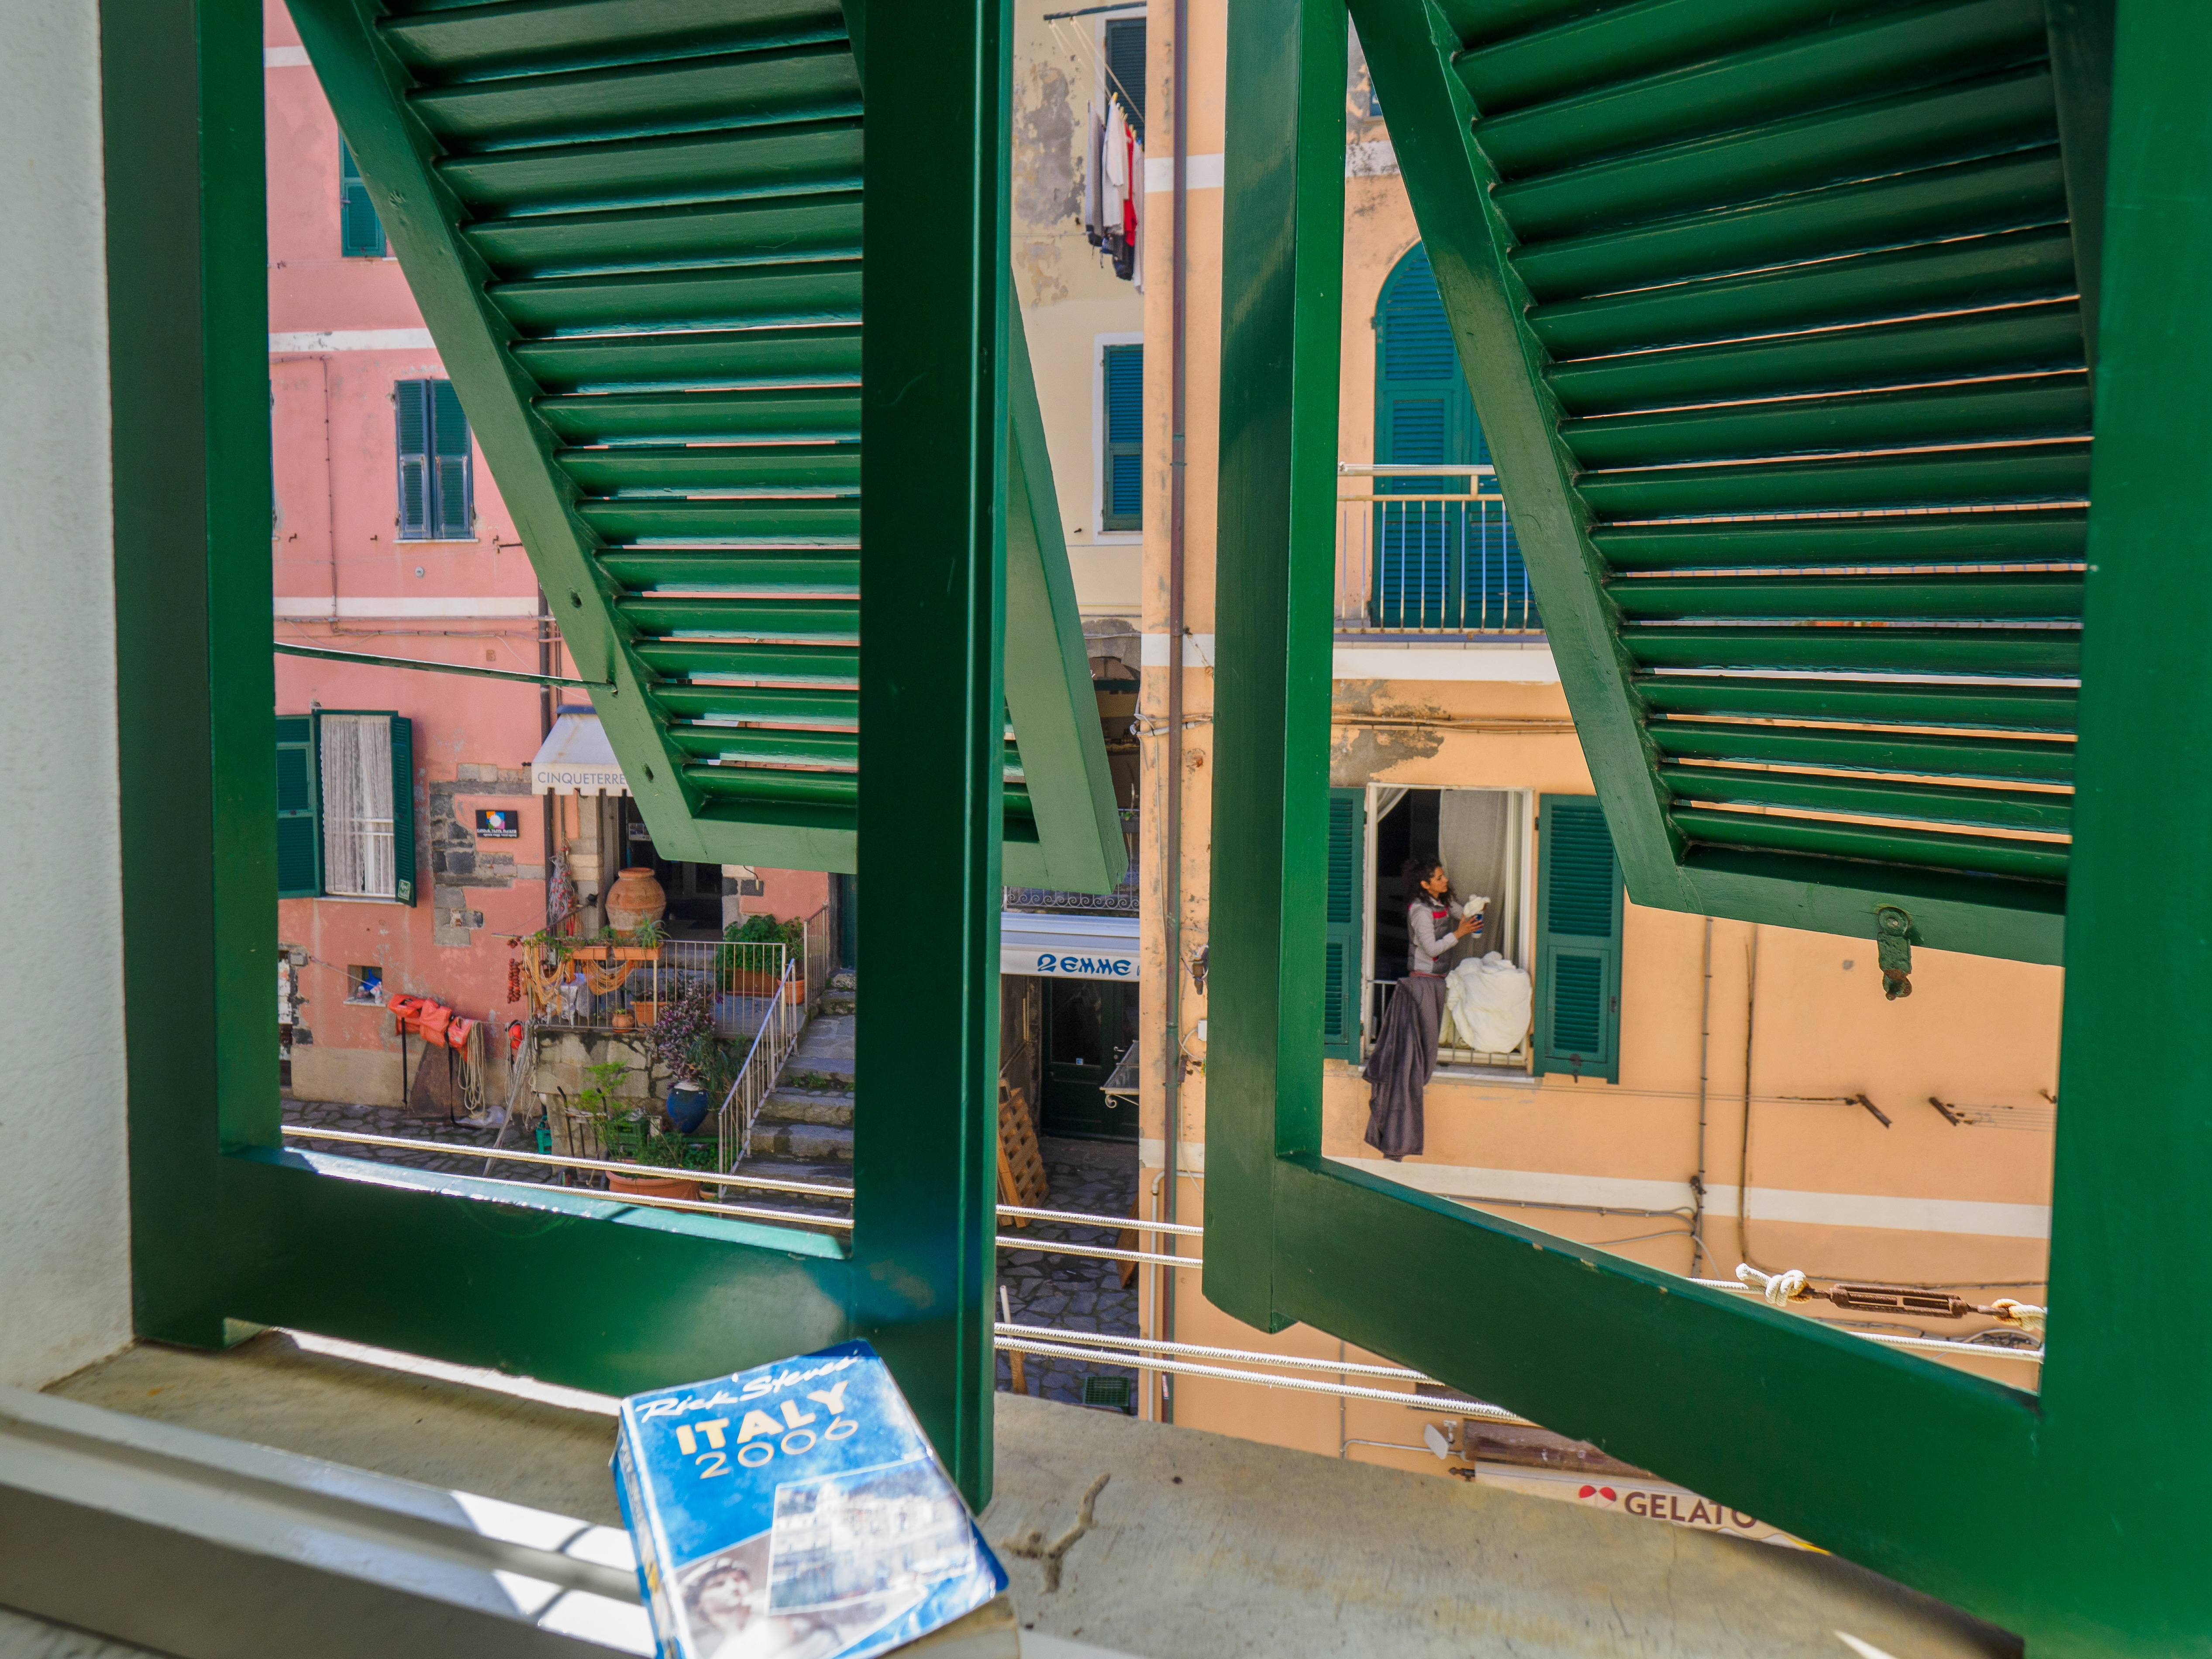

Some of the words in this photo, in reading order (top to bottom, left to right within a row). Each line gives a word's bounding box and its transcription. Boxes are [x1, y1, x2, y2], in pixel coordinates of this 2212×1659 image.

[537, 771, 625, 785] CINQUETERRE
[635, 1391, 738, 1423] Rick
[675, 1380, 848, 1456] ITALY
[695, 1416, 859, 1480] 2006
